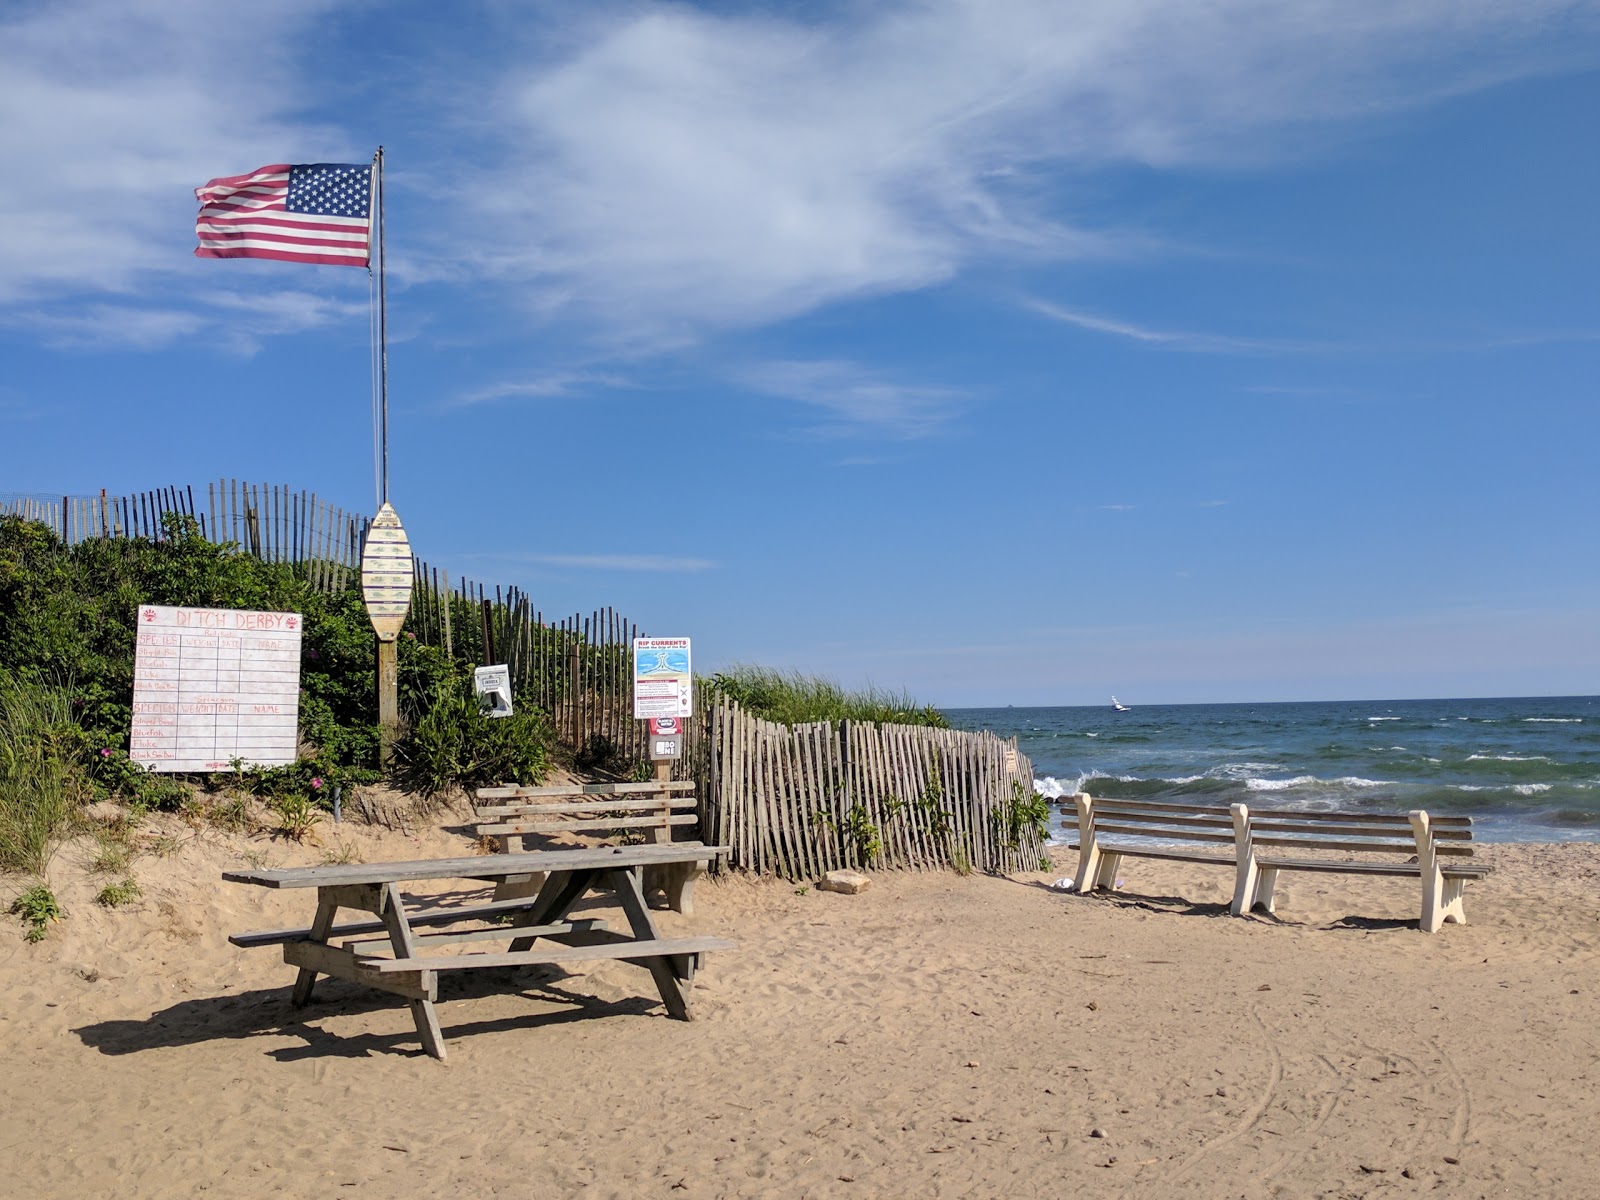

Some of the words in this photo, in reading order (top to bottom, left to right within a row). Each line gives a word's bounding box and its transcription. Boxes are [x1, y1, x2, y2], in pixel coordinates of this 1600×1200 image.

[177, 610, 226, 628] DITCH
[235, 613, 284, 630] DERBY
[140, 634, 177, 646] SPECIES
[258, 640, 283, 649] NAME
[134, 703, 176, 713] SPECIES
[181, 704, 215, 713] WEIGHT
[217, 705, 237, 713] DATE
[254, 705, 281, 714] NAME
